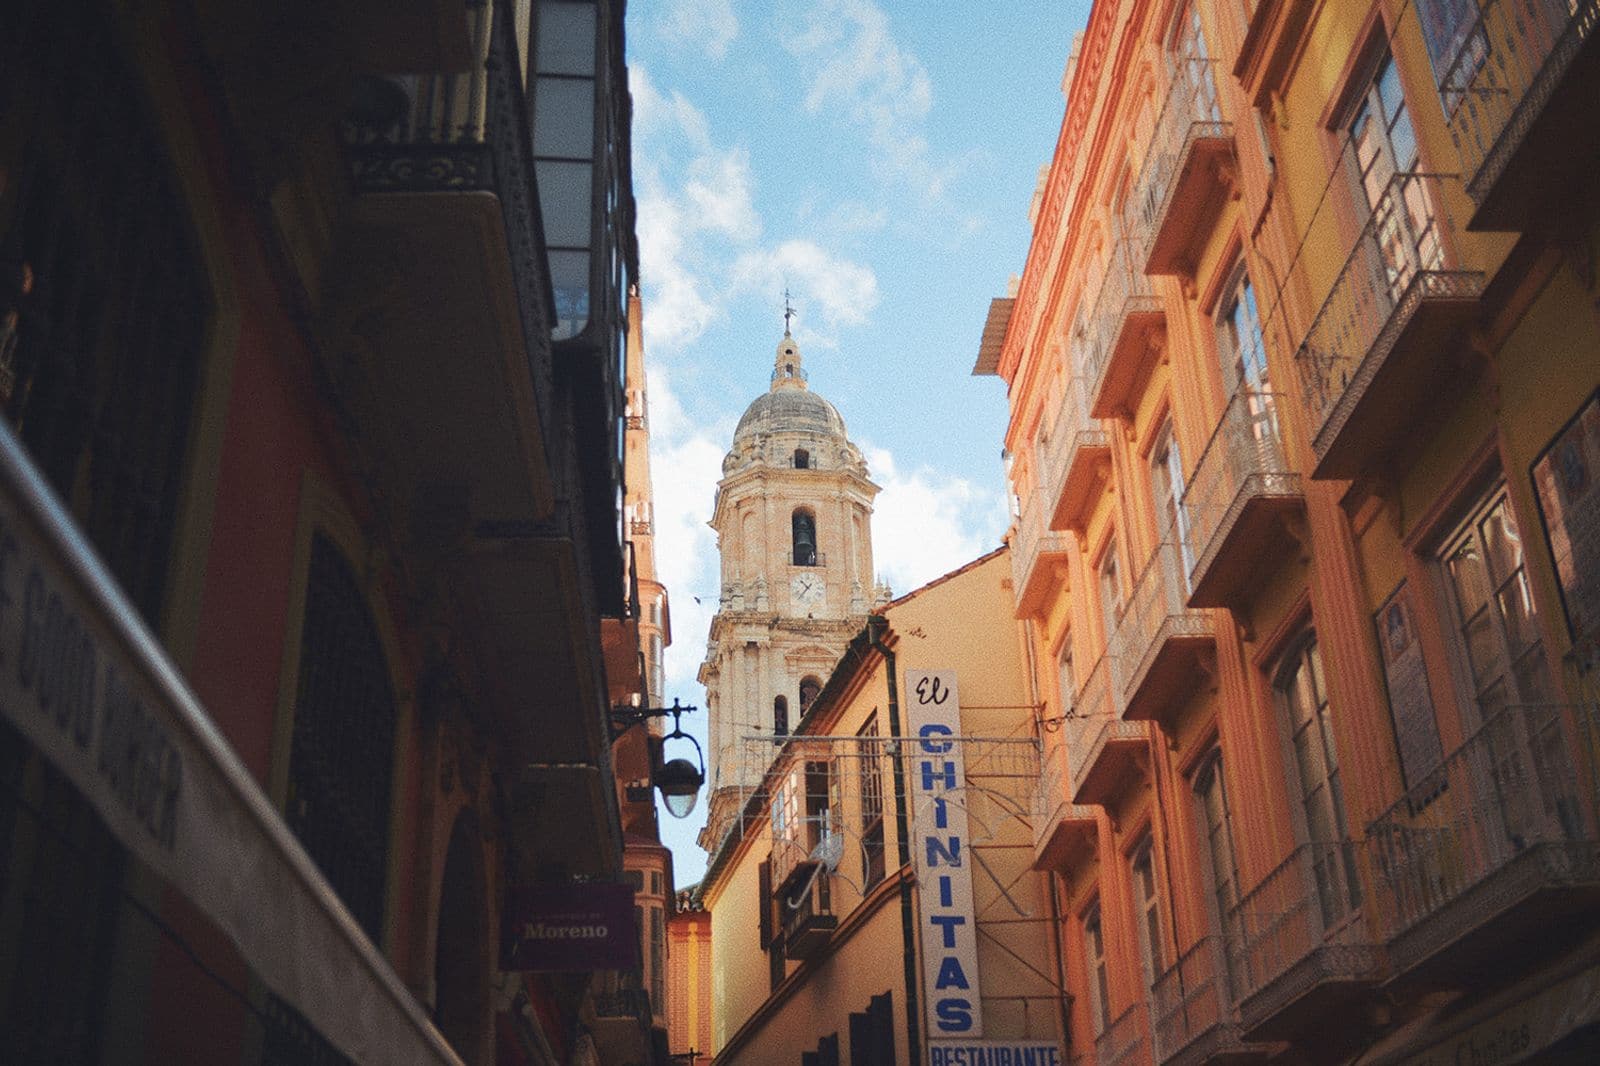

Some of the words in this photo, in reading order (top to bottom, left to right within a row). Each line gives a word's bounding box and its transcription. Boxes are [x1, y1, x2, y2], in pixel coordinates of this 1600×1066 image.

[916, 676, 949, 705] El
[918, 724, 973, 1032] CHINITAS
[524, 923, 608, 939] Moreno
[930, 1046, 1058, 1066] RESTAURANTE
